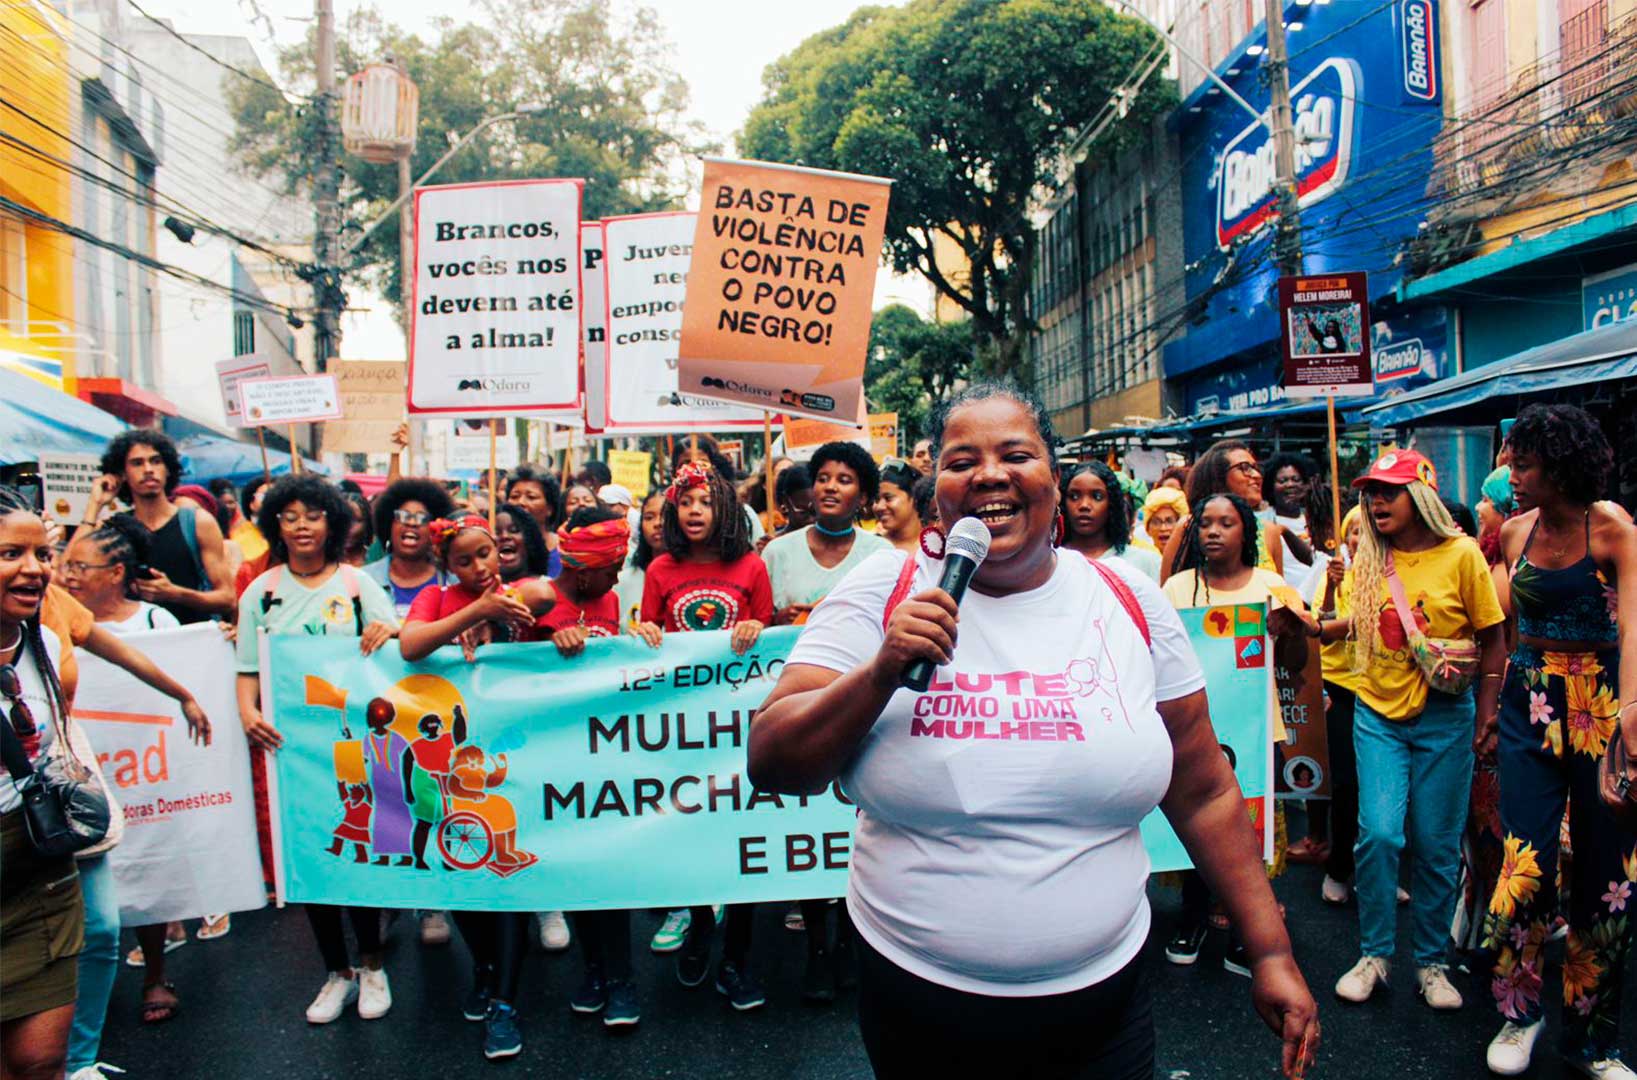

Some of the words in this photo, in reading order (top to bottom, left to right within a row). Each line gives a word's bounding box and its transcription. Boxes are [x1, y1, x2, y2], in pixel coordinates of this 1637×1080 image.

[1407, 4, 1428, 89] BAIANÃO
[715, 185, 815, 219] BASTA
[828, 200, 871, 227] DE
[435, 221, 559, 242] Brancos,
[712, 214, 864, 258] VIOLÊNCIA
[427, 255, 508, 278] vocês
[516, 257, 567, 275] nos
[720, 248, 845, 286] CONTRA
[421, 295, 518, 315] devem
[528, 289, 574, 311] até
[612, 299, 684, 318] empo
[722, 278, 743, 302] O
[754, 282, 837, 315] POVO
[446, 335, 462, 350] a
[471, 327, 555, 349] alma!
[616, 328, 680, 345] consc
[717, 309, 833, 346] NEGRO!
[927, 670, 1069, 697] LUTE
[914, 694, 999, 718] COMO
[1012, 697, 1078, 721] UMA
[588, 710, 758, 754] MULH
[910, 718, 1086, 741] MULHER
[157, 789, 233, 814] Domésticas
[739, 836, 769, 875] E
[786, 831, 849, 873] BE
